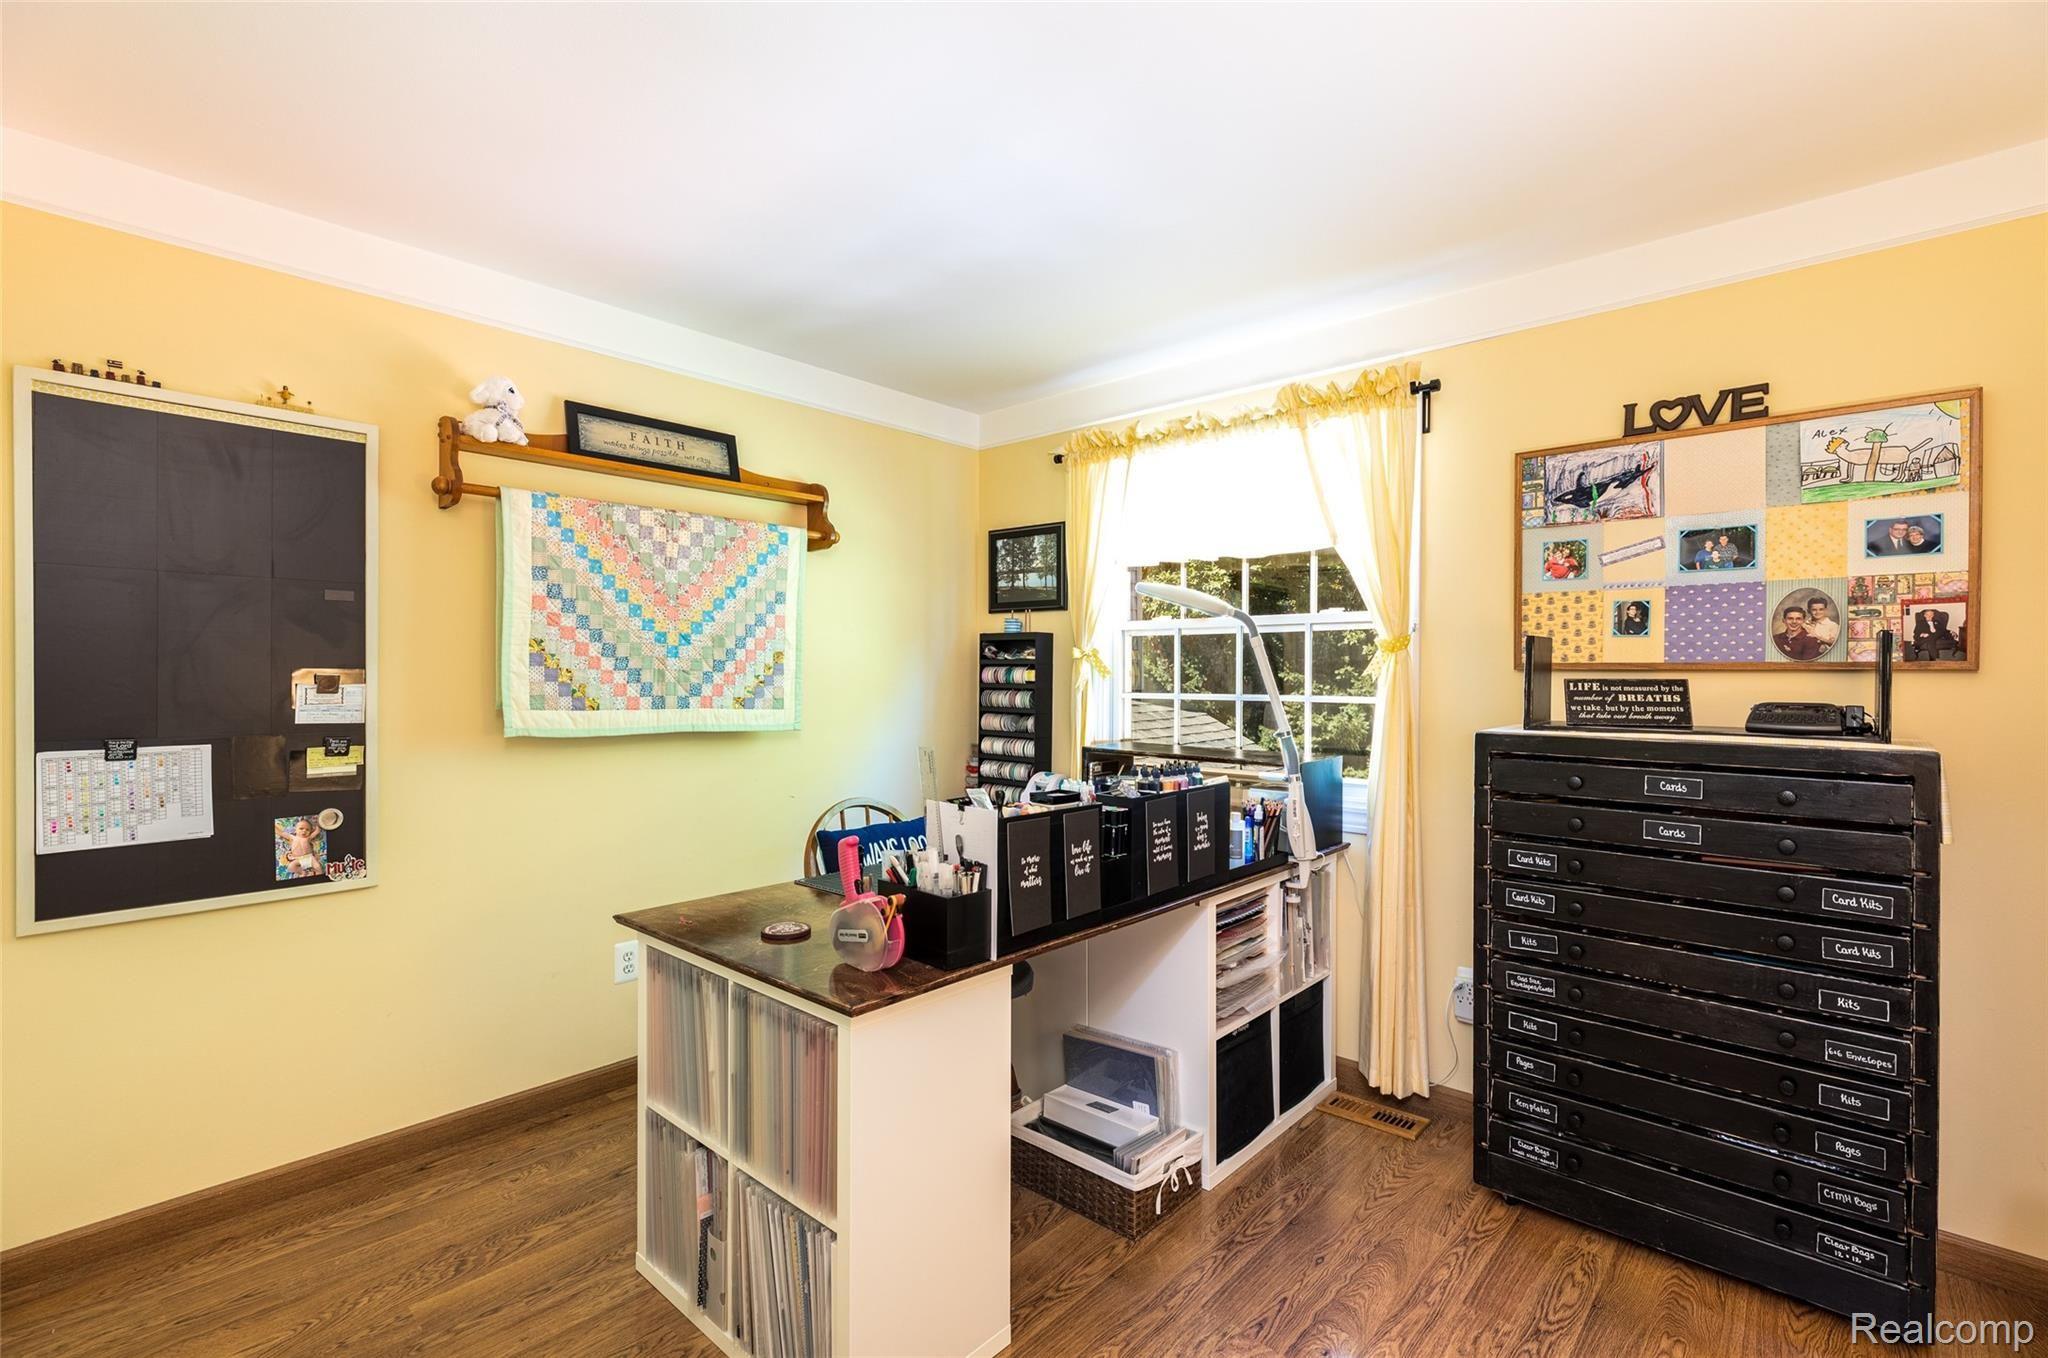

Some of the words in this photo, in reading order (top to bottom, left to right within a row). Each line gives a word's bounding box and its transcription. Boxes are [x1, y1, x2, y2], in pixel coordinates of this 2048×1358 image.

[1623, 383, 1769, 438] LOVE
[603, 440, 627, 449] makes
[629, 443, 650, 455] things
[630, 432, 685, 451] FAITH
[1569, 682, 1600, 691] LIFE
[1604, 693, 1616, 703] of
[1618, 694, 1681, 702] BREATHS
[1620, 705, 1629, 713] by
[1628, 712, 1652, 720] breath
[1660, 781, 1687, 793] Cards
[1658, 826, 1686, 838] Cards
[1516, 854, 1534, 864] Card
[1535, 856, 1551, 867] Kits
[1020, 875, 1042, 888] matters
[1512, 891, 1530, 903] Card
[1530, 895, 1546, 906] Kits
[1832, 893, 1858, 907] Card
[1860, 897, 1883, 911] Kits
[1521, 936, 1538, 947] Kits
[1835, 943, 1860, 956] Card
[1862, 946, 1882, 960] Kits
[1837, 997, 1860, 1011] Kits
[1523, 1020, 1538, 1031] Kits
[1516, 1056, 1534, 1070] Pages
[1846, 1050, 1893, 1069] Envelopes
[1515, 1098, 1551, 1115] Templates
[1840, 1093, 1862, 1107] Kits
[1518, 1140, 1534, 1151] Clear
[1534, 1146, 1550, 1158] Bags
[1835, 1141, 1862, 1158] Pages
[1824, 1188, 1852, 1204] CTMH
[1854, 1196, 1878, 1213] Bags
[1824, 1236, 1850, 1251] Clear
[1852, 1246, 1875, 1260] Bags
